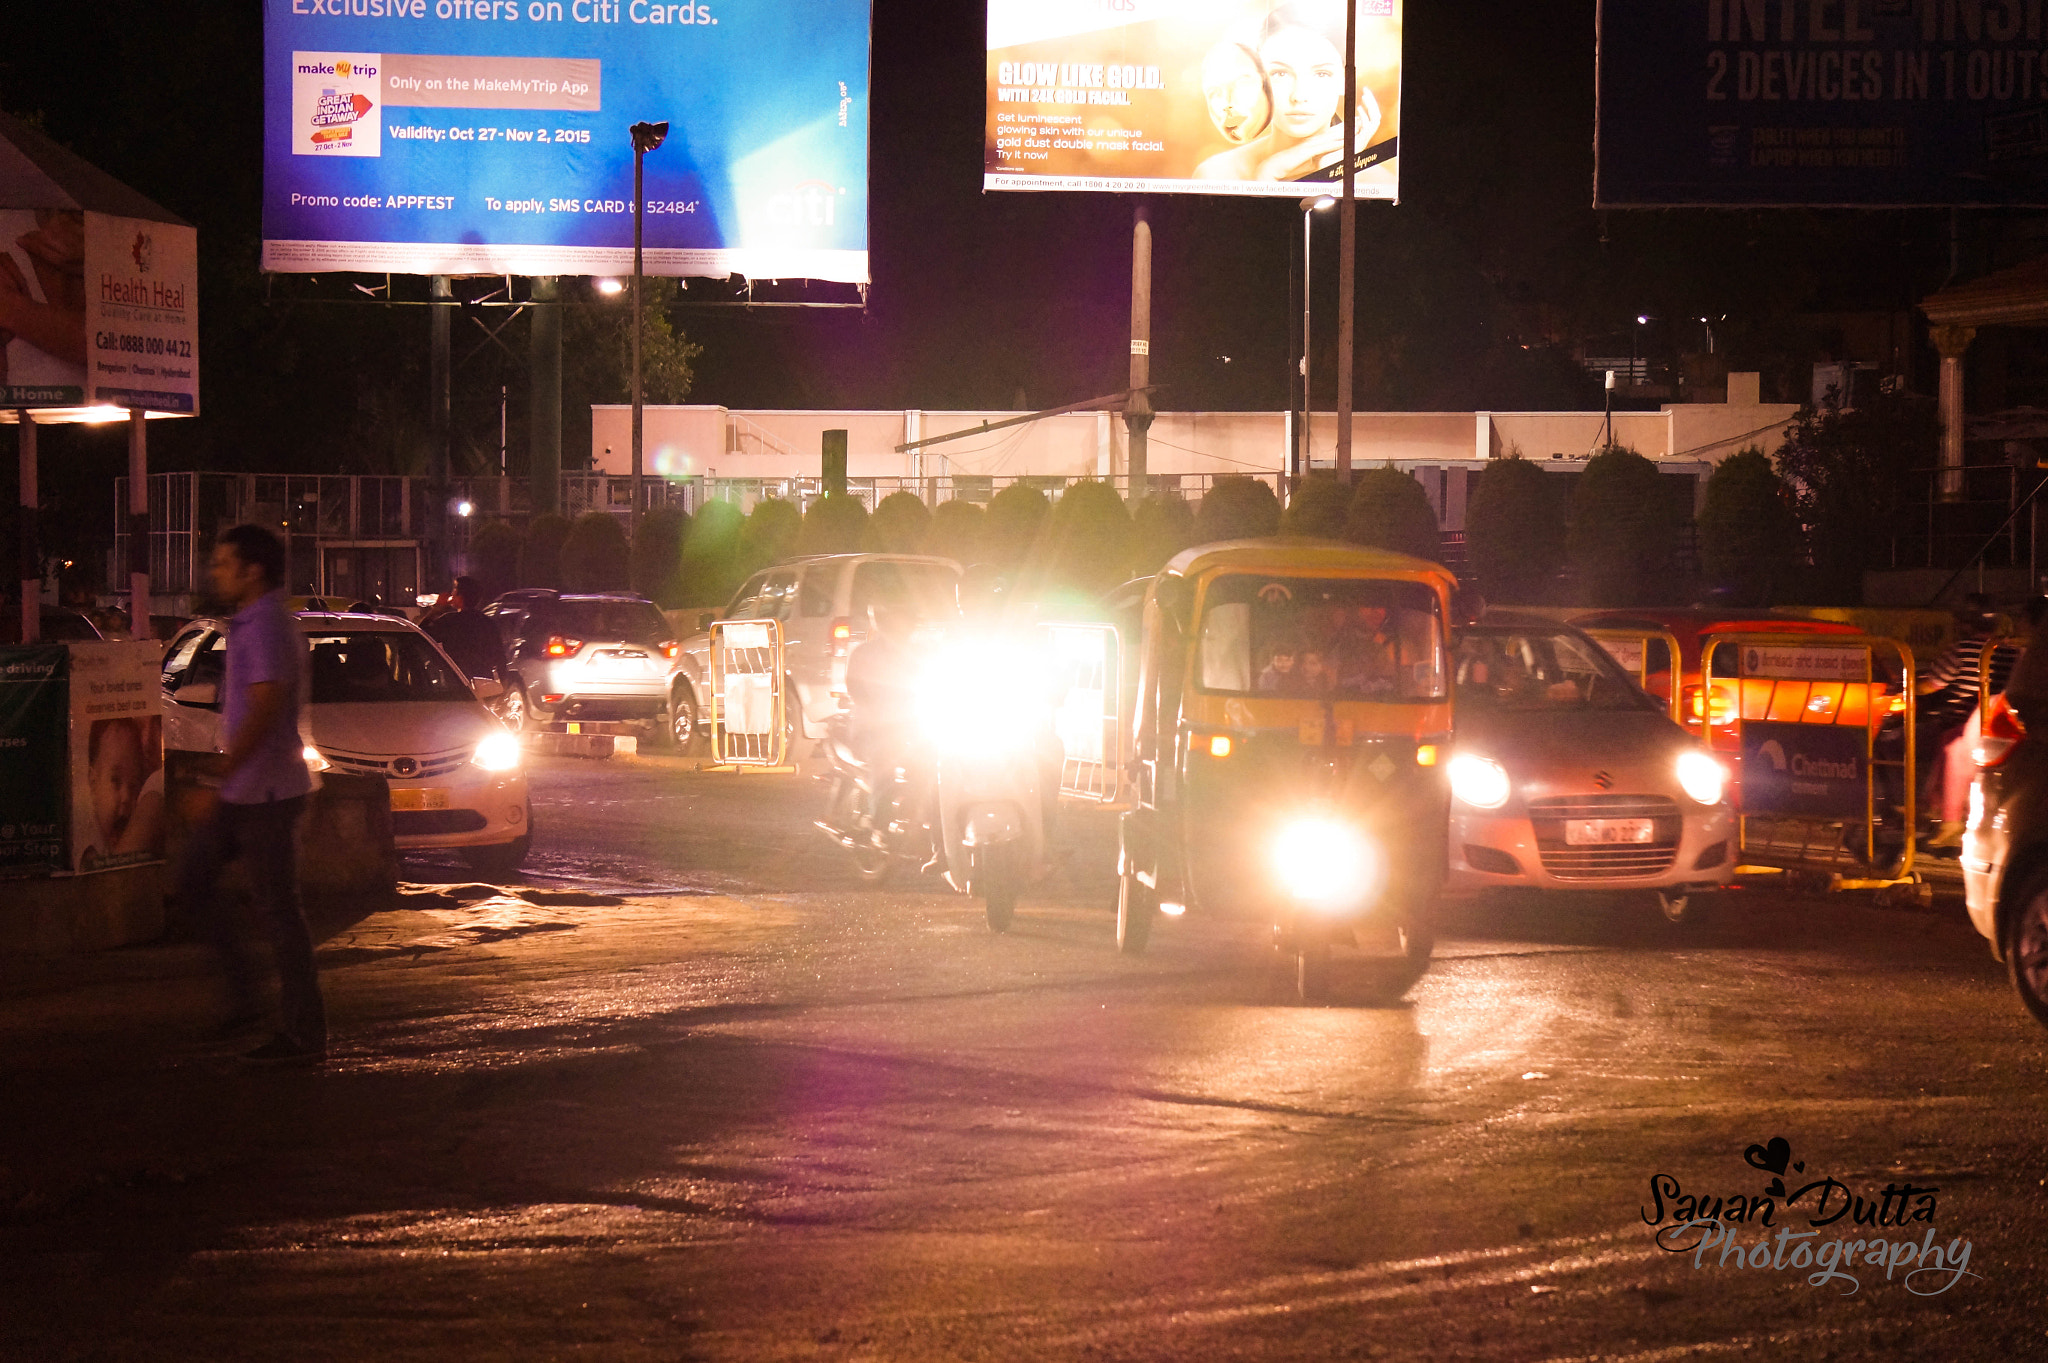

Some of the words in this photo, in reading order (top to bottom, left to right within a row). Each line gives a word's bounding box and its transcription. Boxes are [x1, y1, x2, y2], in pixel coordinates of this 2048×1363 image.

[528, 0, 563, 22] on
[572, 0, 619, 23] Citi
[629, 0, 719, 25] Cards.
[298, 62, 335, 74] make
[353, 63, 377, 79] trip
[998, 62, 1059, 86] GLOW
[1061, 63, 1105, 88] LIKE
[1107, 65, 1166, 89] GOLD.
[1706, 50, 1728, 100] 2
[1737, 50, 1884, 100] DEVICES
[1893, 50, 1929, 100] IN
[1940, 50, 1955, 100] 1
[389, 75, 422, 92] Only
[425, 78, 443, 90] on
[446, 77, 470, 90] the
[474, 78, 558, 94] MakeMyTrip
[561, 80, 589, 95] App
[318, 93, 353, 106] GREAT
[998, 88, 1031, 102] WITH
[1032, 89, 1056, 103] 24K
[1056, 89, 1088, 104] GOLD
[1088, 91, 1133, 105] FACIAL.
[317, 102, 354, 115] INDIAN
[311, 111, 360, 125] GETAWAY
[997, 113, 1016, 122] Get
[1017, 114, 1082, 124] luminescent
[389, 125, 446, 142] Validity:
[449, 127, 475, 140] Oct
[537, 129, 551, 144] 2,
[555, 129, 591, 143] 2015
[997, 125, 1037, 136] glowing
[1039, 126, 1060, 135] skin
[1062, 127, 1085, 136] with
[1106, 129, 1143, 138] unique
[996, 137, 1021, 148] gold
[1024, 138, 1050, 148] dust
[1053, 138, 1093, 150] double
[1096, 140, 1130, 151] mask
[996, 150, 1013, 160] Try
[1014, 150, 1021, 159] it
[995, 177, 1010, 185] For
[1011, 178, 1065, 188] appointment,
[1067, 179, 1082, 187] call
[1085, 180, 1103, 188] 1800
[1124, 181, 1133, 189] 20
[291, 193, 339, 207] Promo
[343, 195, 382, 208] code:
[386, 195, 455, 210] APPFEST
[484, 197, 501, 211] To
[505, 197, 545, 214] apply,
[549, 198, 580, 213] SMS
[583, 199, 625, 213] CARD
[101, 274, 148, 305] Health
[153, 281, 185, 309] Heal
[96, 331, 118, 351] Call:
[119, 334, 144, 354] 0888
[146, 337, 164, 355] 000
[166, 339, 178, 356] 44
[180, 340, 192, 358] 22
[13, 387, 65, 401] Home
[6, 662, 54, 676] driving
